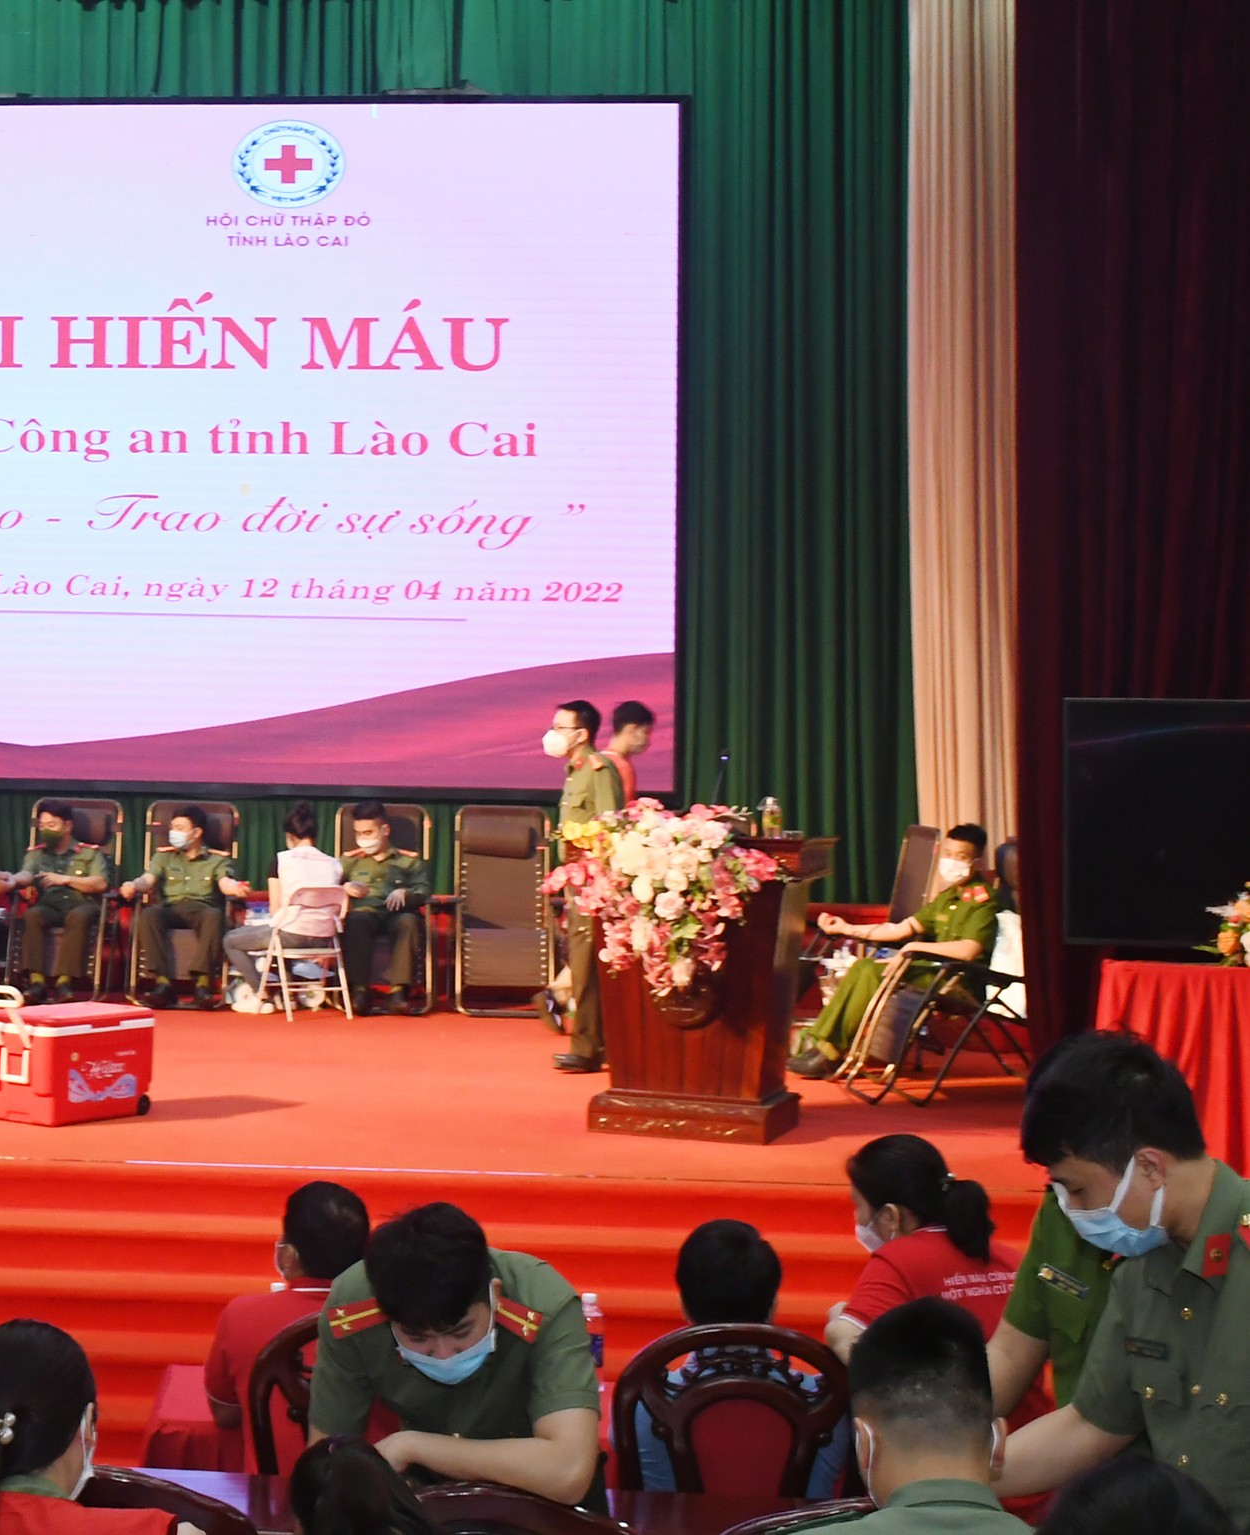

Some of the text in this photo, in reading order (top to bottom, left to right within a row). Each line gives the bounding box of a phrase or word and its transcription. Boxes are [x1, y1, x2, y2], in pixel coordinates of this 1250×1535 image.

[206, 211, 371, 229] HỘI CHỮ THẬP ĐỎ
[227, 231, 349, 247] TỈNH LÀO CAI
[50, 291, 277, 370] HIẾN
[301, 298, 510, 372] MÁU
[129, 430, 189, 454] an
[209, 418, 310, 455] tỉnh
[330, 420, 429, 456] Lào
[449, 421, 537, 457] Cai
[87, 494, 224, 532] Trao
[241, 496, 330, 533] đời
[336, 509, 402, 540] sự
[409, 499, 535, 551] sống
[66, 574, 129, 600] Cai,
[143, 577, 229, 602] ngày
[241, 578, 279, 598] 12
[291, 578, 395, 605] tháng
[404, 580, 441, 600] 04
[454, 581, 531, 602] năm
[542, 582, 623, 603] 2022
